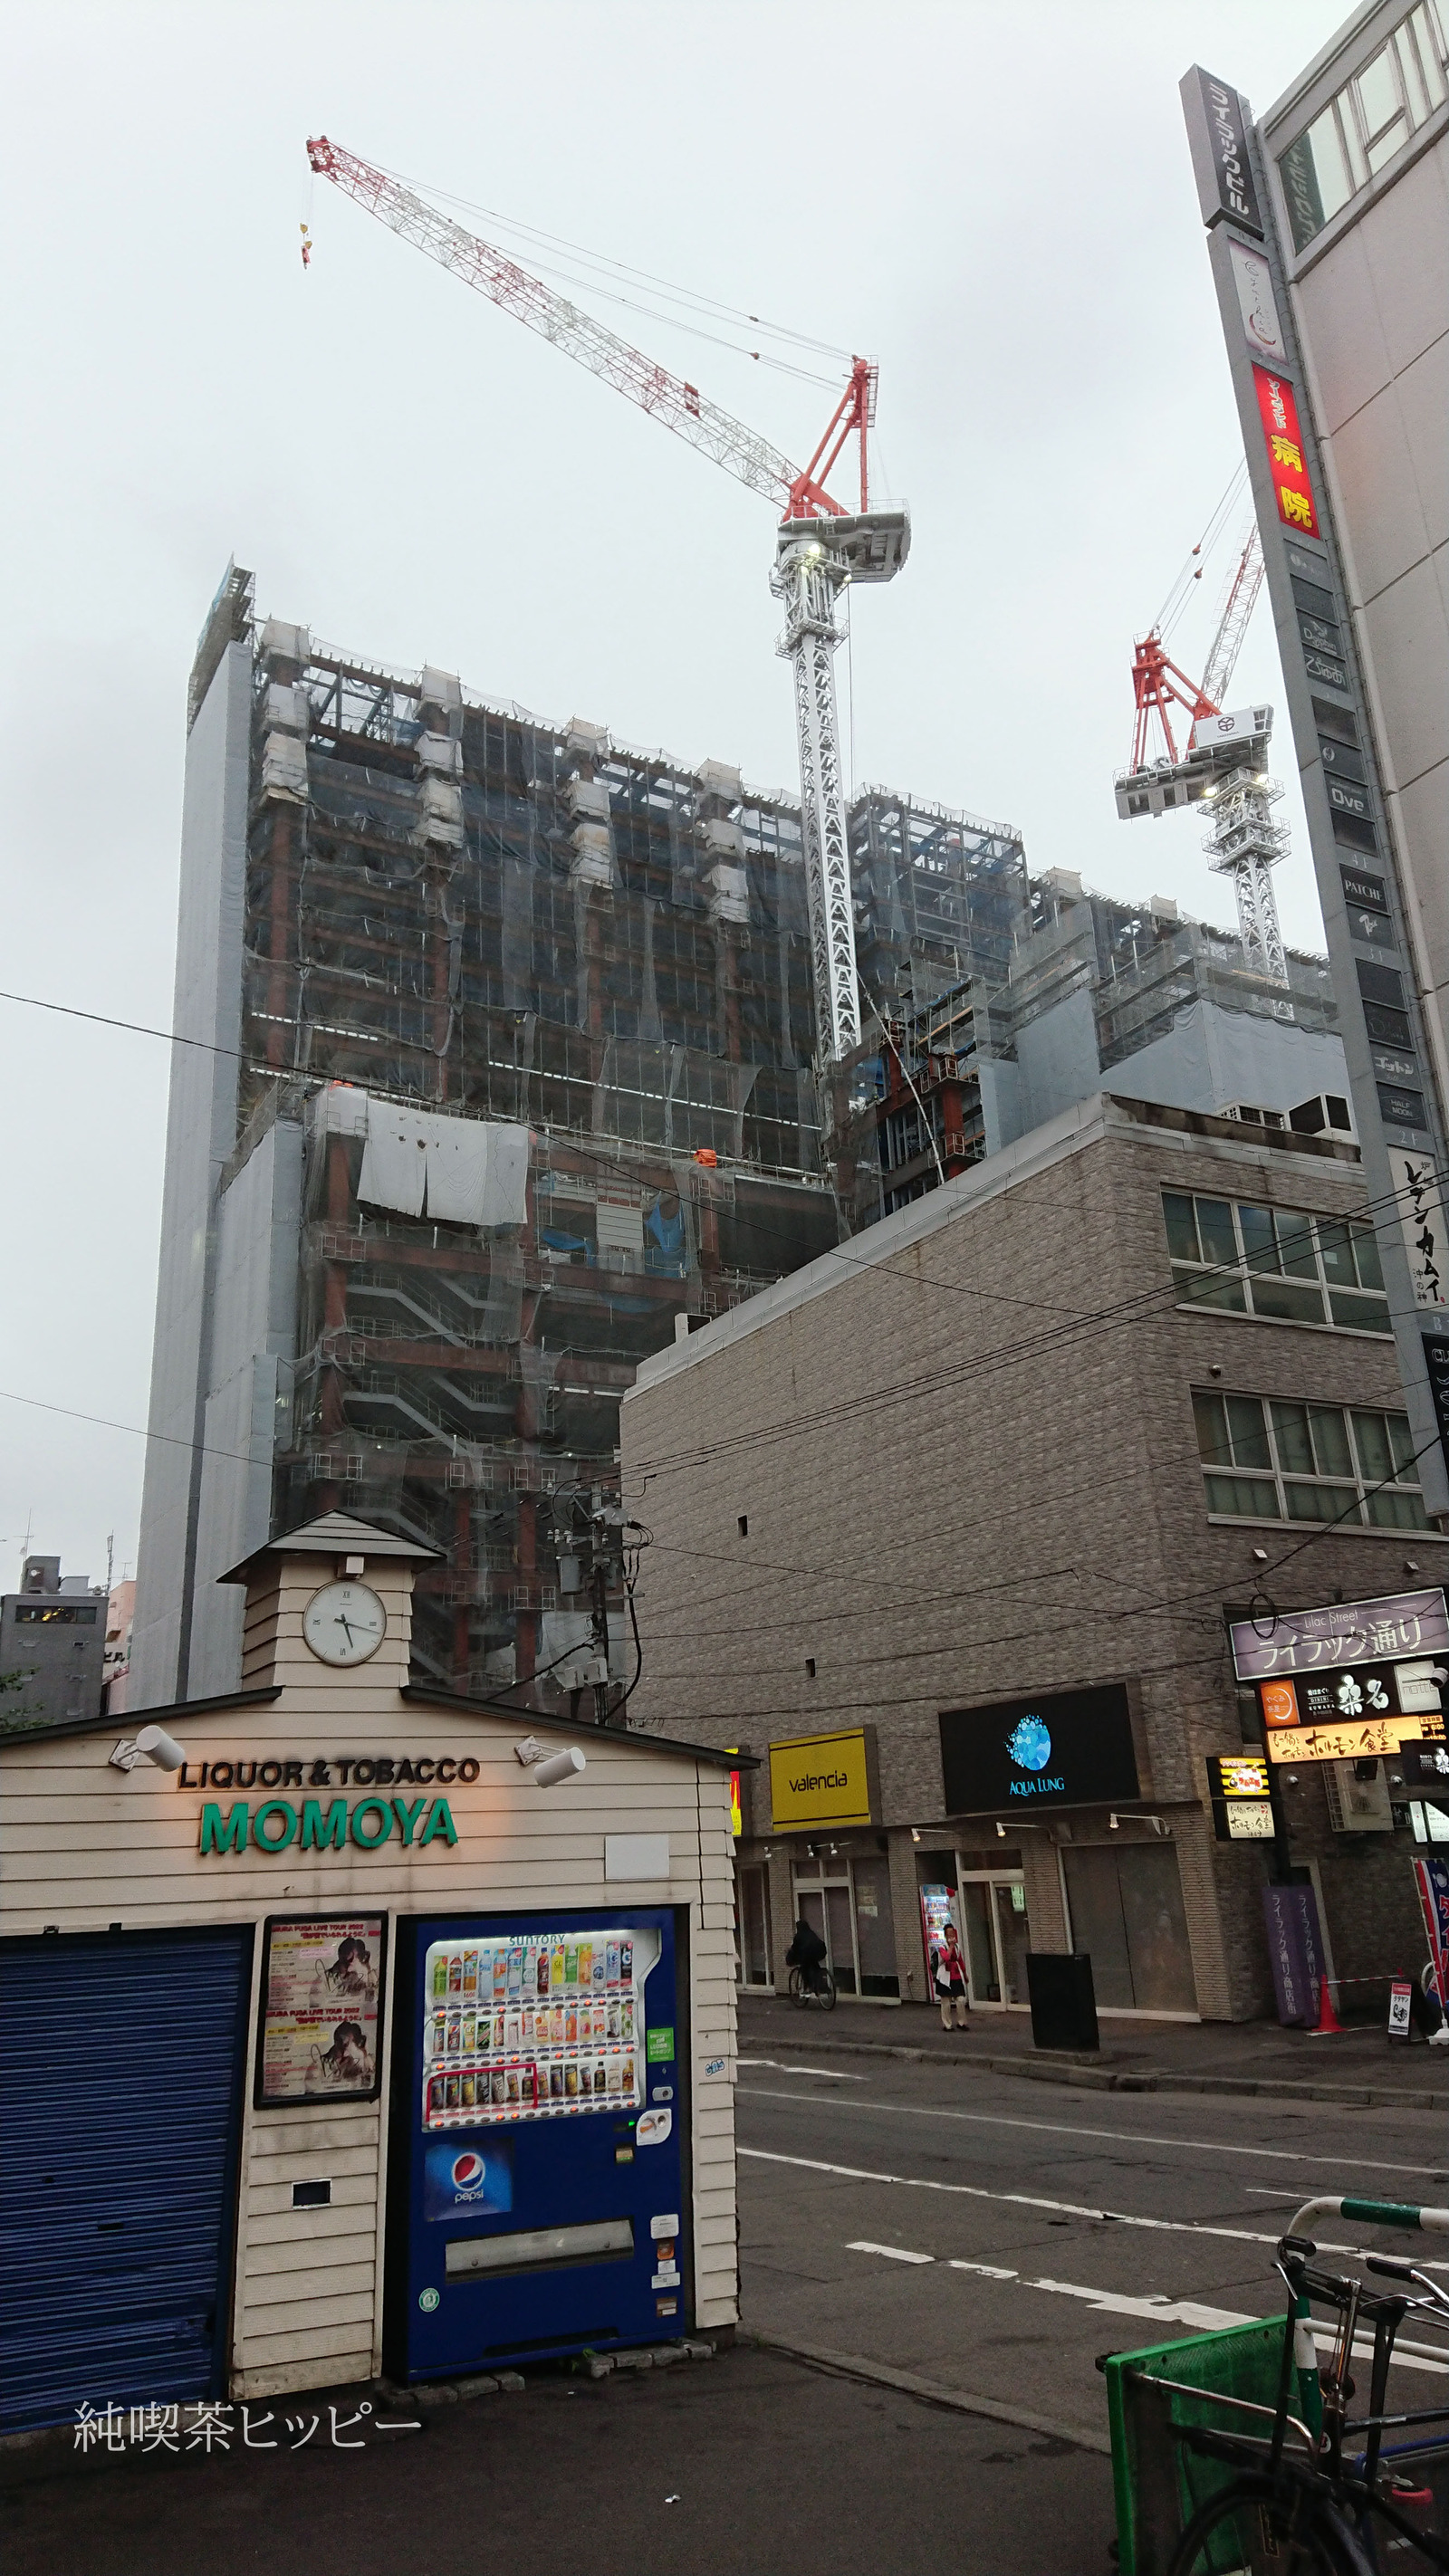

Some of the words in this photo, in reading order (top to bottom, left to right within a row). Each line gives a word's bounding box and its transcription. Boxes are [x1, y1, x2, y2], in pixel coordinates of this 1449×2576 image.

[1209, 81, 1250, 215] ライラックビル
[1271, 434, 1313, 530] 病院
[1391, 1098, 1411, 1109] HALF
[1392, 1106, 1414, 1118] MOON
[1304, 1615, 1327, 1629] Lilac
[1329, 1609, 1358, 1625] Street
[1257, 1615, 1421, 1669] ライラック通り
[1305, 1721, 1395, 1757] ホルモン食堂
[178, 1761, 302, 1788] LIQUOR
[310, 1759, 331, 1786] &
[335, 1758, 480, 1785] TOBACCO
[788, 1769, 848, 1793] valencia
[1009, 1779, 1037, 1797] AQUA
[1038, 1776, 1065, 1793] LUNG
[199, 1797, 459, 1854] MOMOYA
[508, 1934, 566, 1947] SUNTORY
[1271, 1894, 1297, 2015] ライラック通り商店街
[455, 2188, 485, 2204] pepsi
